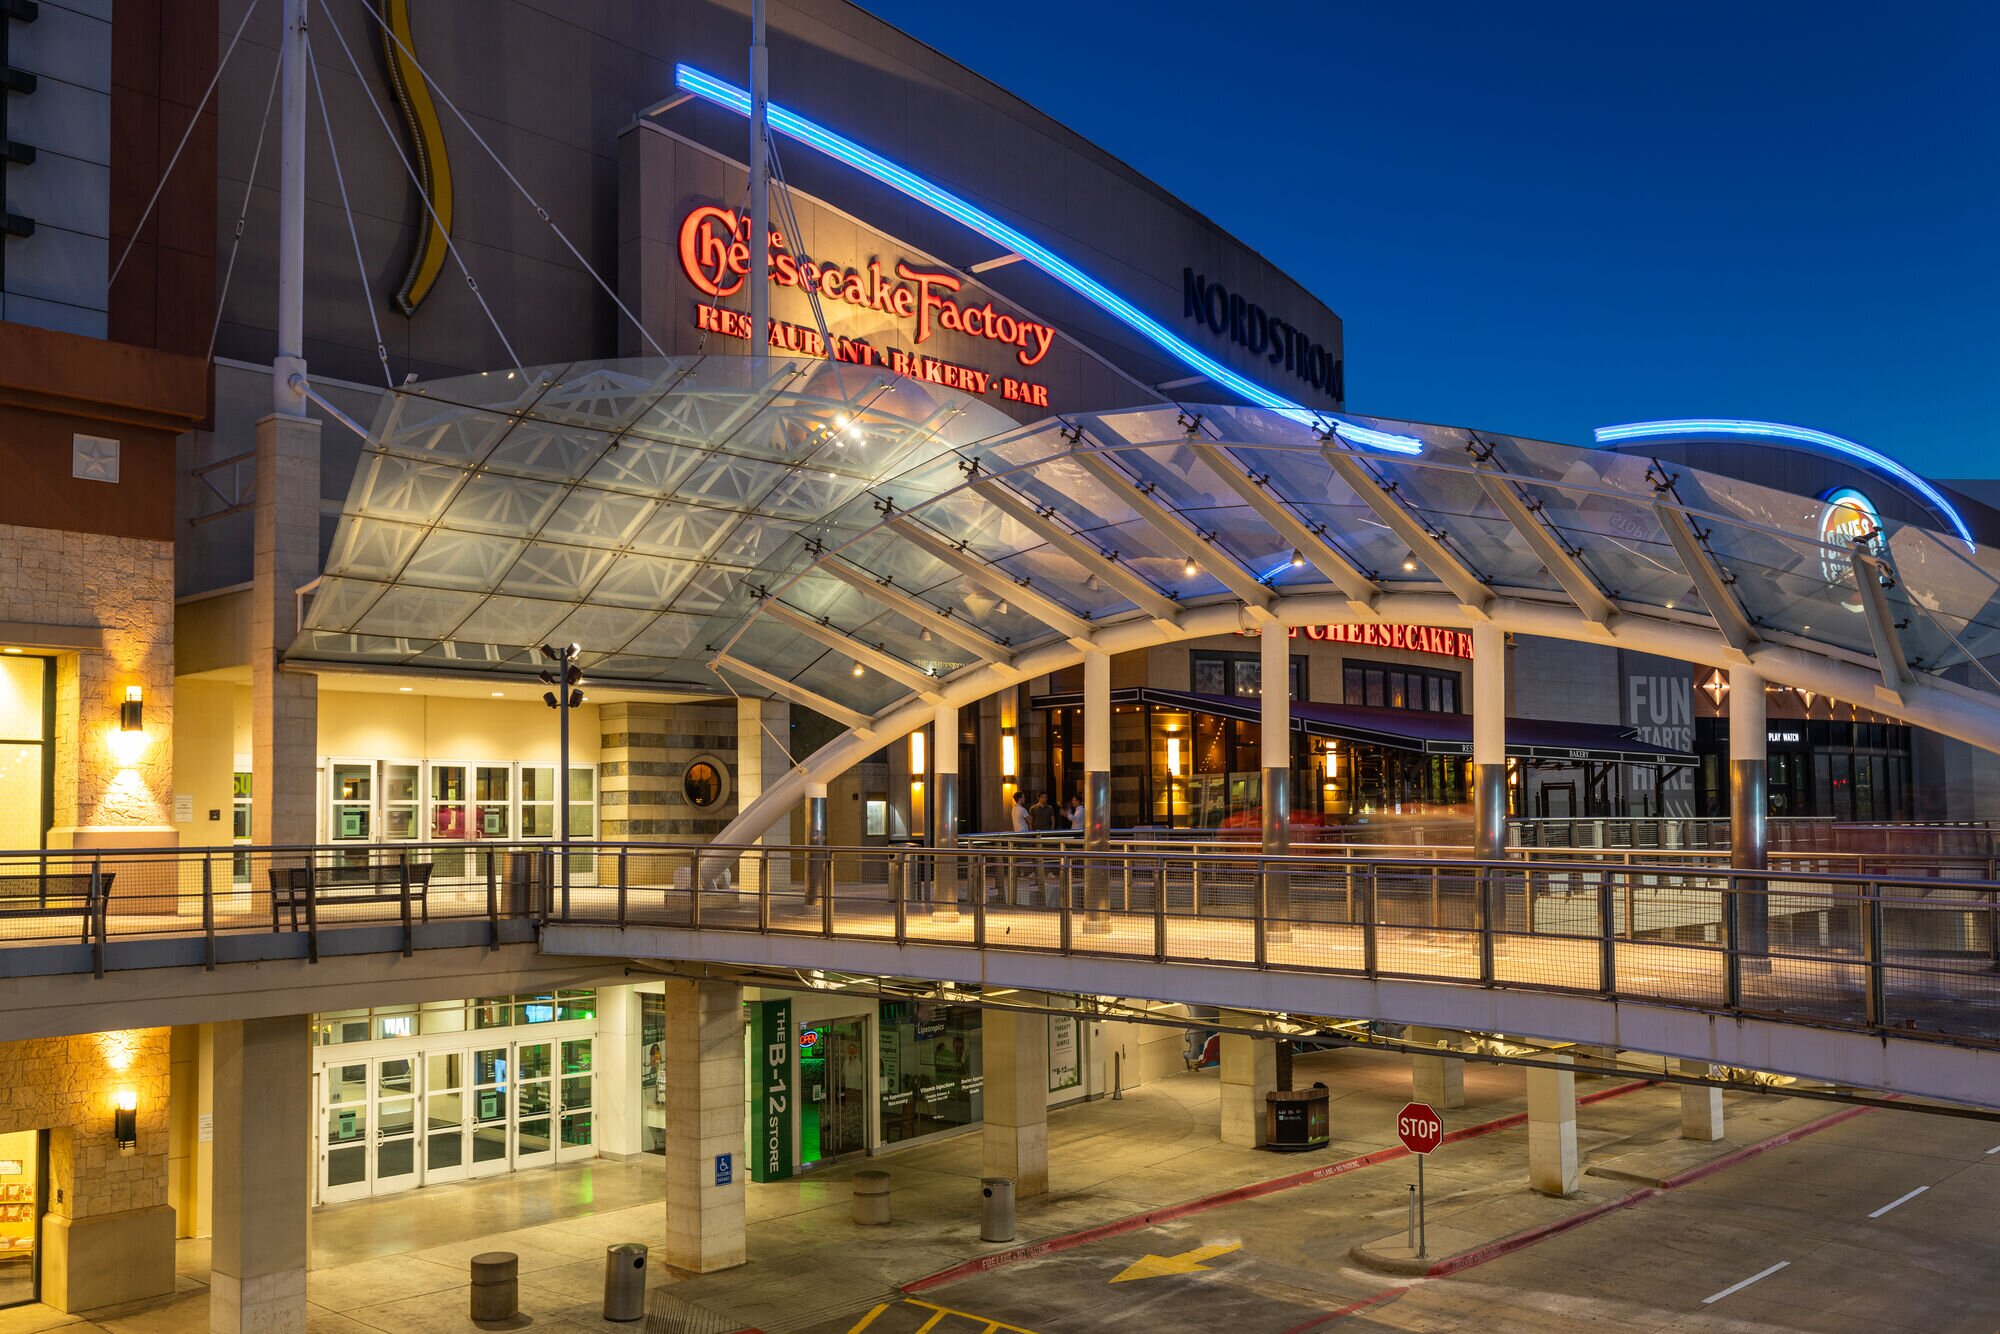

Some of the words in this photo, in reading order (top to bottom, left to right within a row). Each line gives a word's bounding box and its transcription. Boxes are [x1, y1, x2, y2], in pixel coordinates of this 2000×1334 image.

[740, 215, 785, 248] Te
[897, 263, 1056, 366] Factory
[1183, 267, 1344, 402] NORDSTROM
[696, 303, 877, 367] RESAURANT
[891, 351, 990, 395] BAKERY
[1002, 377, 1049, 407] BAR
[1305, 624, 1456, 656] CHEESECAKE
[1629, 675, 1691, 725] FUN
[1768, 732, 1781, 742] PLAY
[1783, 732, 1800, 742] WATCH
[1569, 749, 1590, 759] BAKERY
[1657, 755, 1667, 763] BAR
[1632, 765, 1693, 791] HRE
[776, 1008, 786, 1044] THE
[917, 1023, 945, 1035] Lipotropics
[1054, 1023, 1071, 1032] THERAPY
[1057, 1031, 1069, 1039] MADE
[800, 1033, 817, 1045] OPEN
[1056, 1038, 1070, 1047] SIMPLE
[769, 1042, 787, 1115] B-12
[920, 1086, 936, 1094] Vitamin
[936, 1082, 955, 1091] Injections
[887, 1098, 908, 1107] Necessary
[889, 1090, 913, 1100] Appointment
[1400, 1117, 1439, 1139] STOP
[769, 1117, 780, 1174] STORE
[982, 1257, 995, 1269] FIRE
[996, 1252, 1012, 1265] LANE
[1017, 1249, 1026, 1261] NO
